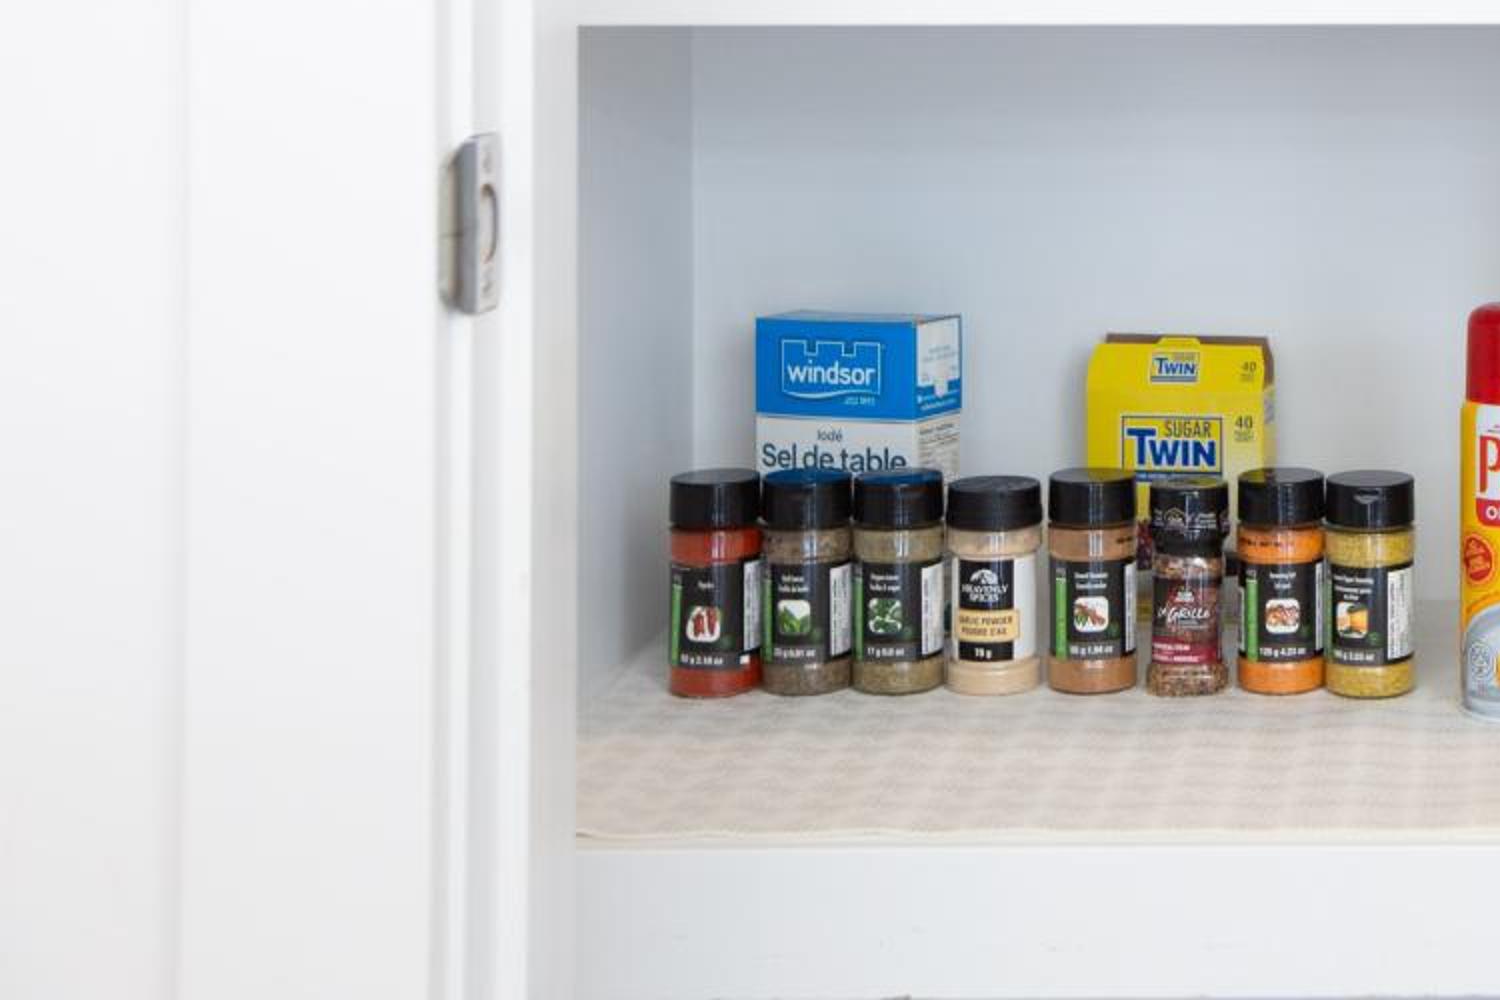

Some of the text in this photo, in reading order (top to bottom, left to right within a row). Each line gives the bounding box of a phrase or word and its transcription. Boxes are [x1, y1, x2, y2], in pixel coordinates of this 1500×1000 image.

[787, 359, 876, 387] windsor
[1154, 357, 1198, 375] TWIN
[1164, 420, 1212, 438] SUGAR
[762, 443, 908, 473] Sel de table
[1126, 428, 1217, 467] TWIN
